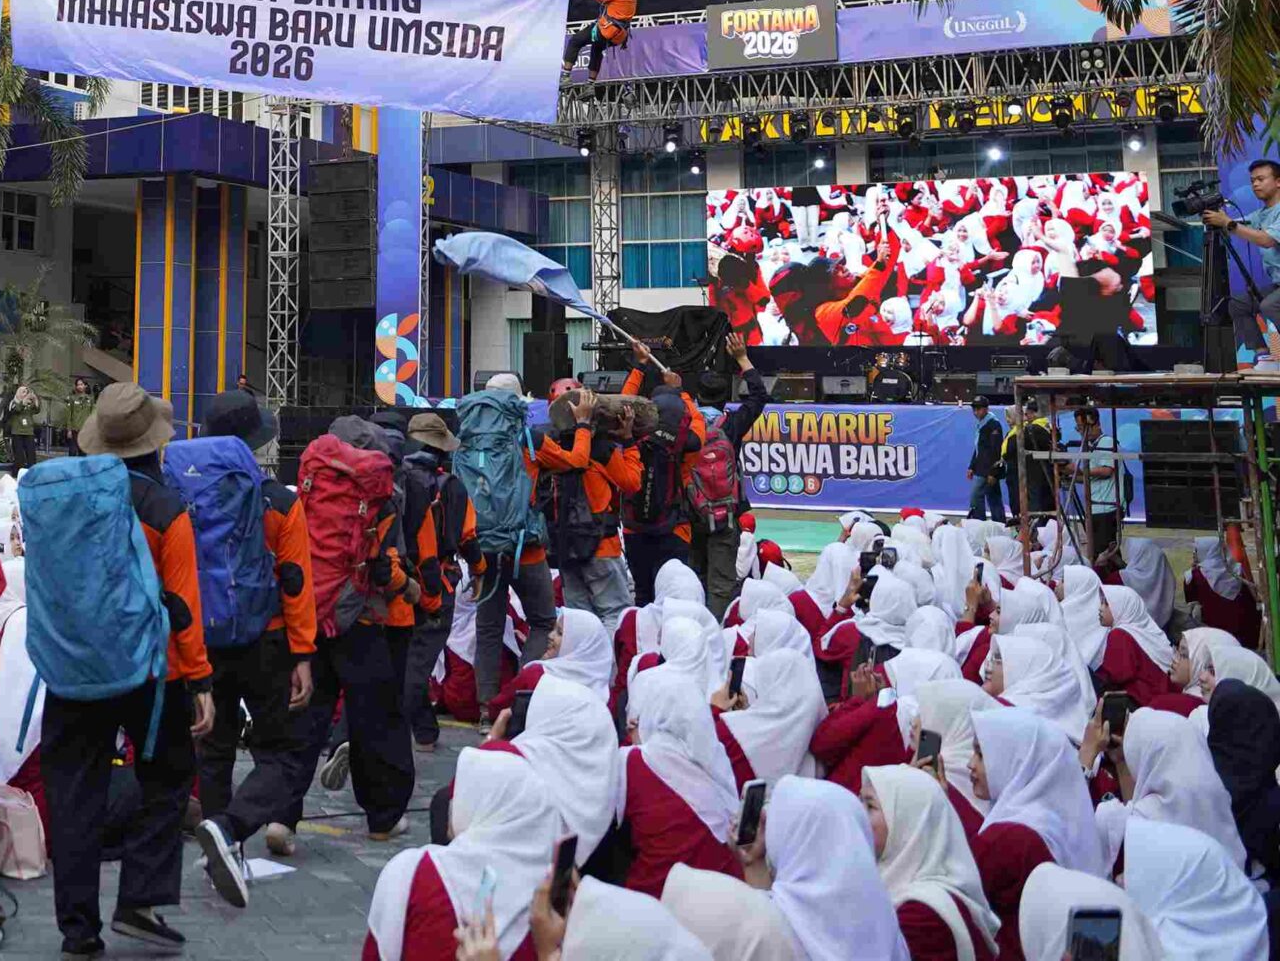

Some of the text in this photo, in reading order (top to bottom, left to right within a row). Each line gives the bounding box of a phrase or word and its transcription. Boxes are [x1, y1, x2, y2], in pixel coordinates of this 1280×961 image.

[268, 7, 357, 48] BARU
[367, 15, 506, 62] UMSIDA
[722, 5, 819, 37] FORTAMA
[954, 16, 1017, 33] UNGGUL
[744, 30, 799, 57] 2026
[229, 40, 315, 82] 2026
[785, 412, 893, 444] TAARUF
[739, 441, 917, 478] SISWA BARU
